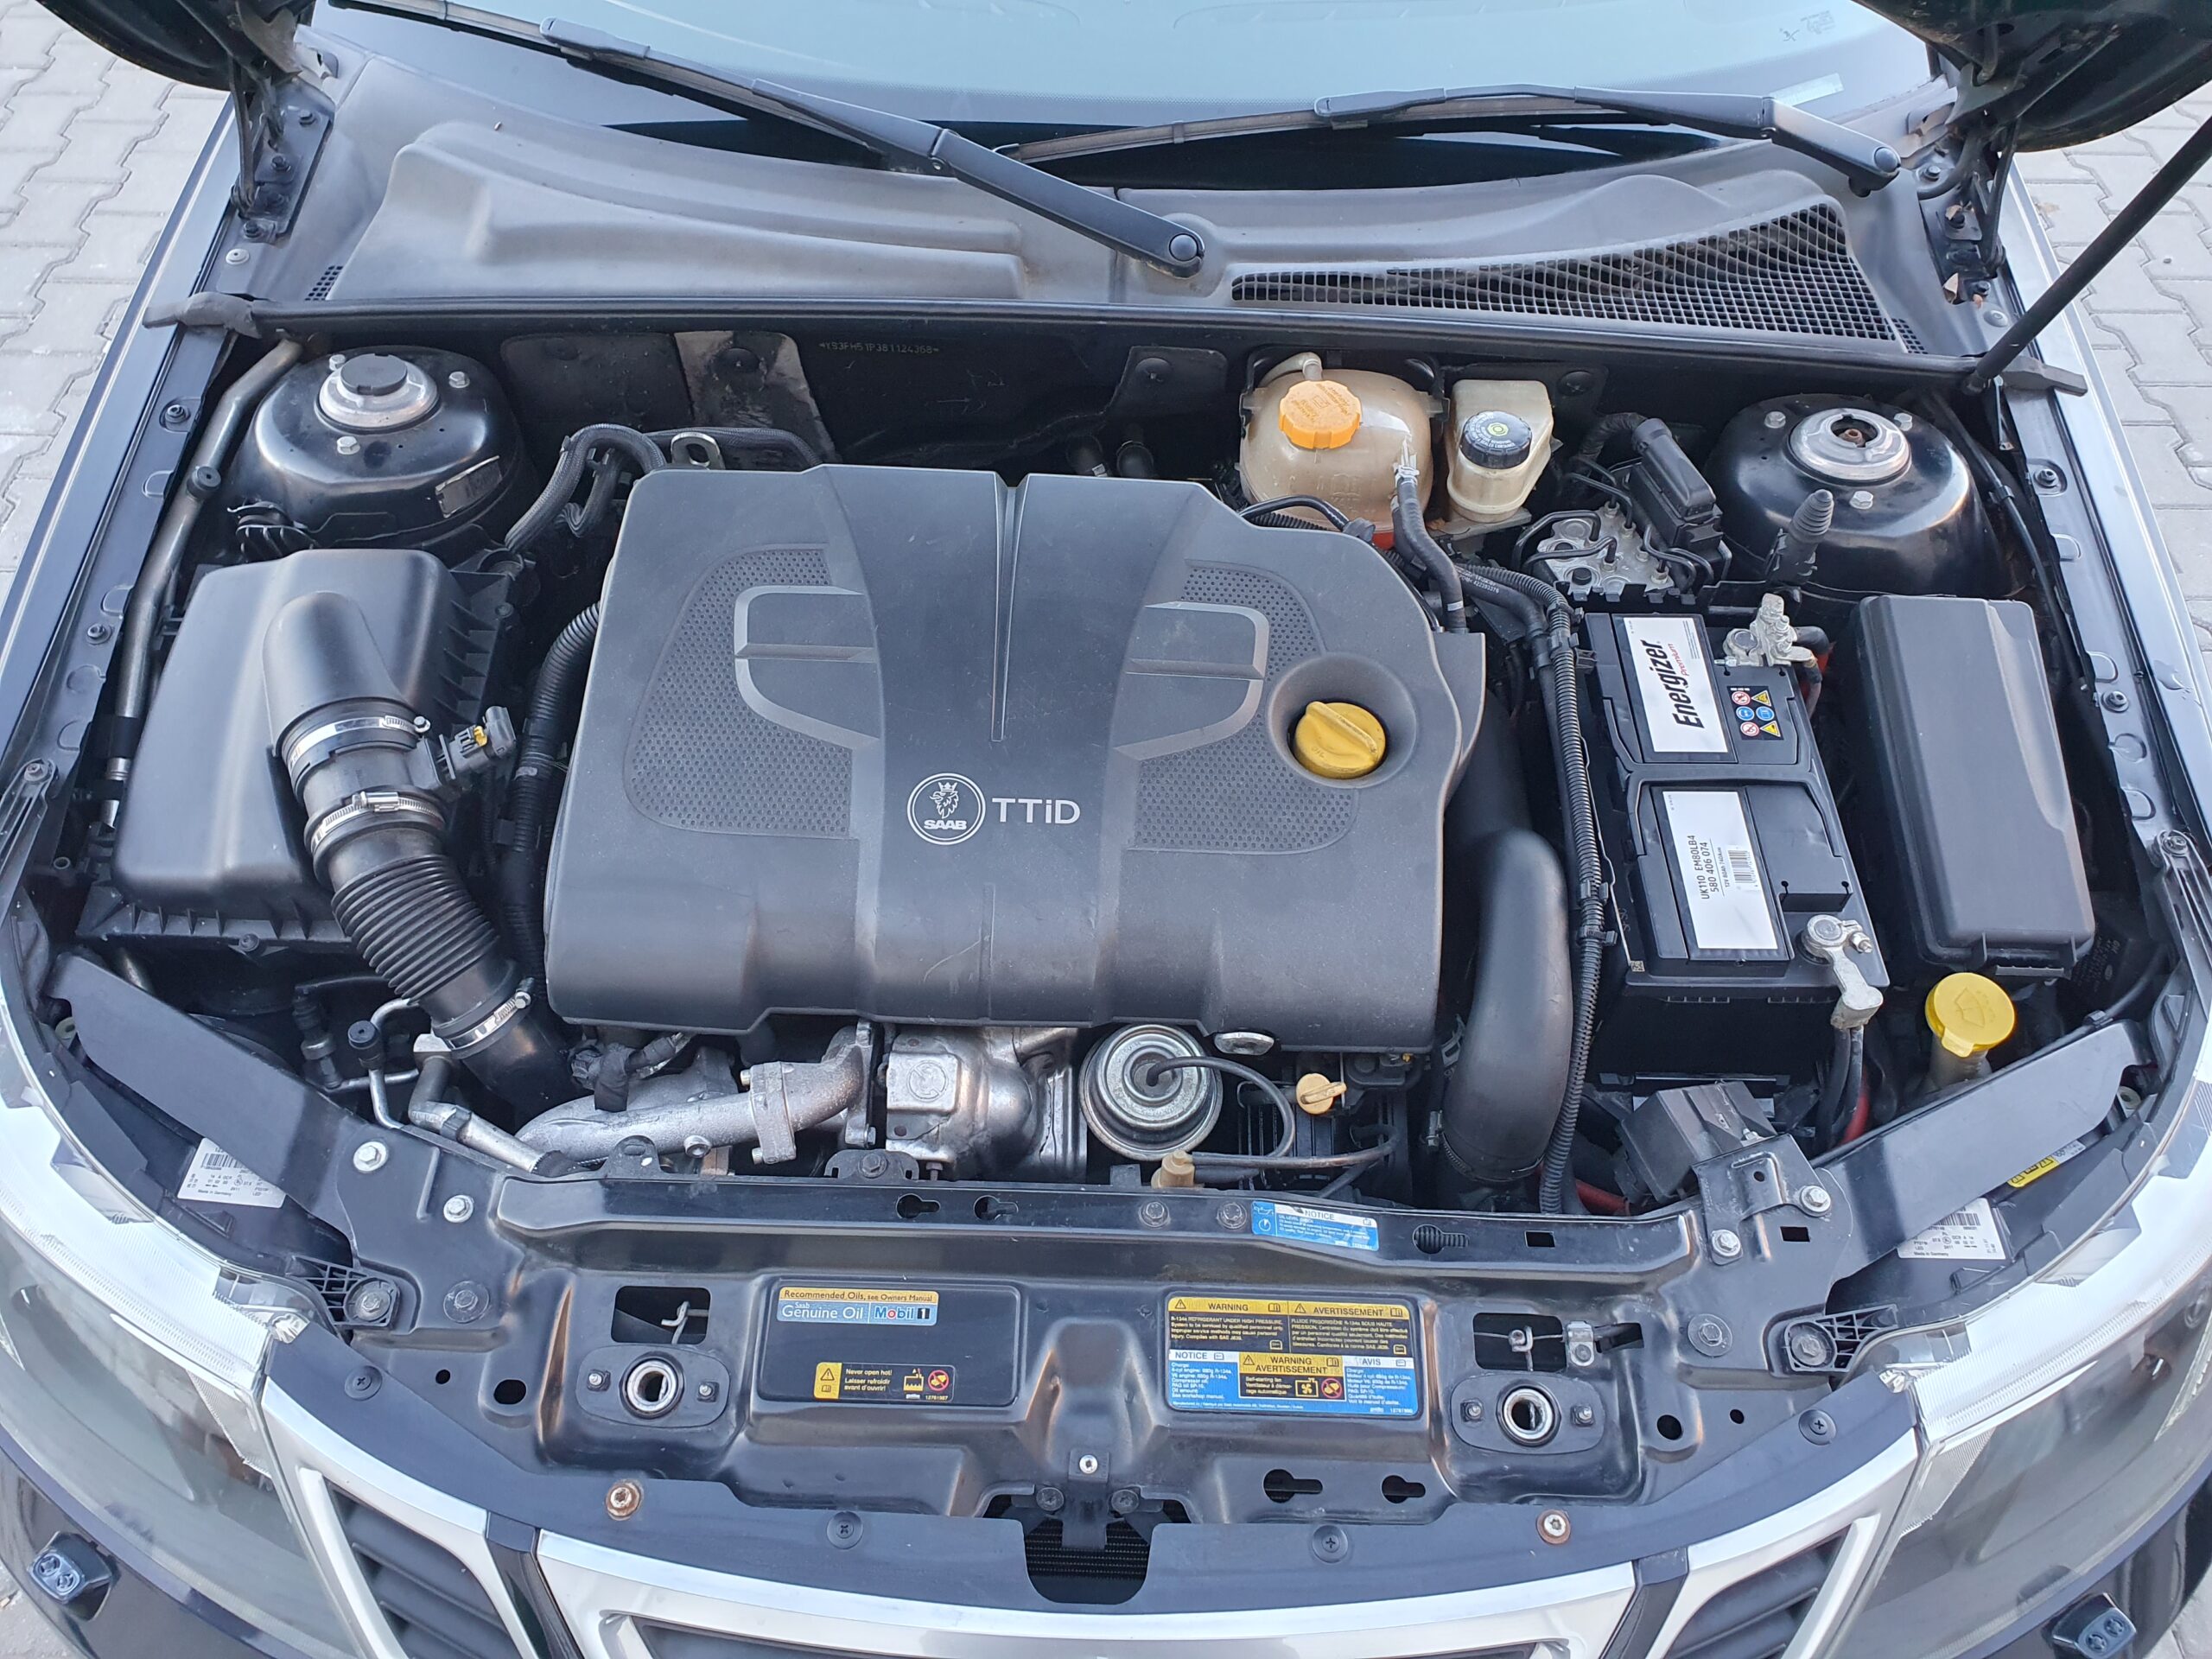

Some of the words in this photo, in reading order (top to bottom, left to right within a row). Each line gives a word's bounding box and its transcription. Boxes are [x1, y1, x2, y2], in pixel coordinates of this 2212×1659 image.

[1668, 643, 1690, 676] Premium
[1640, 639, 1705, 728] Energizer
[992, 798, 1081, 824] TTiD
[924, 819, 967, 830] SAAB
[1687, 835, 1704, 871] EM80LB4
[1700, 842, 1711, 857] 074
[1704, 859, 1715, 874] 406
[1696, 875, 1710, 899] UK110
[1708, 877, 1719, 892] 580
[1305, 1210, 1334, 1220] NOTICE
[784, 1290, 845, 1299] Recommended
[847, 1292, 866, 1300] Oils,
[782, 1305, 838, 1318] Genuine
[843, 1307, 863, 1319] Oil
[875, 1306, 914, 1320] Mobil
[1313, 1307, 1383, 1316] AVERTISSEMENT
[1175, 1352, 1207, 1360] NOTICE
[1270, 1357, 1312, 1365] WARNING
[1256, 1365, 1327, 1374] AVERTISSEMENT
